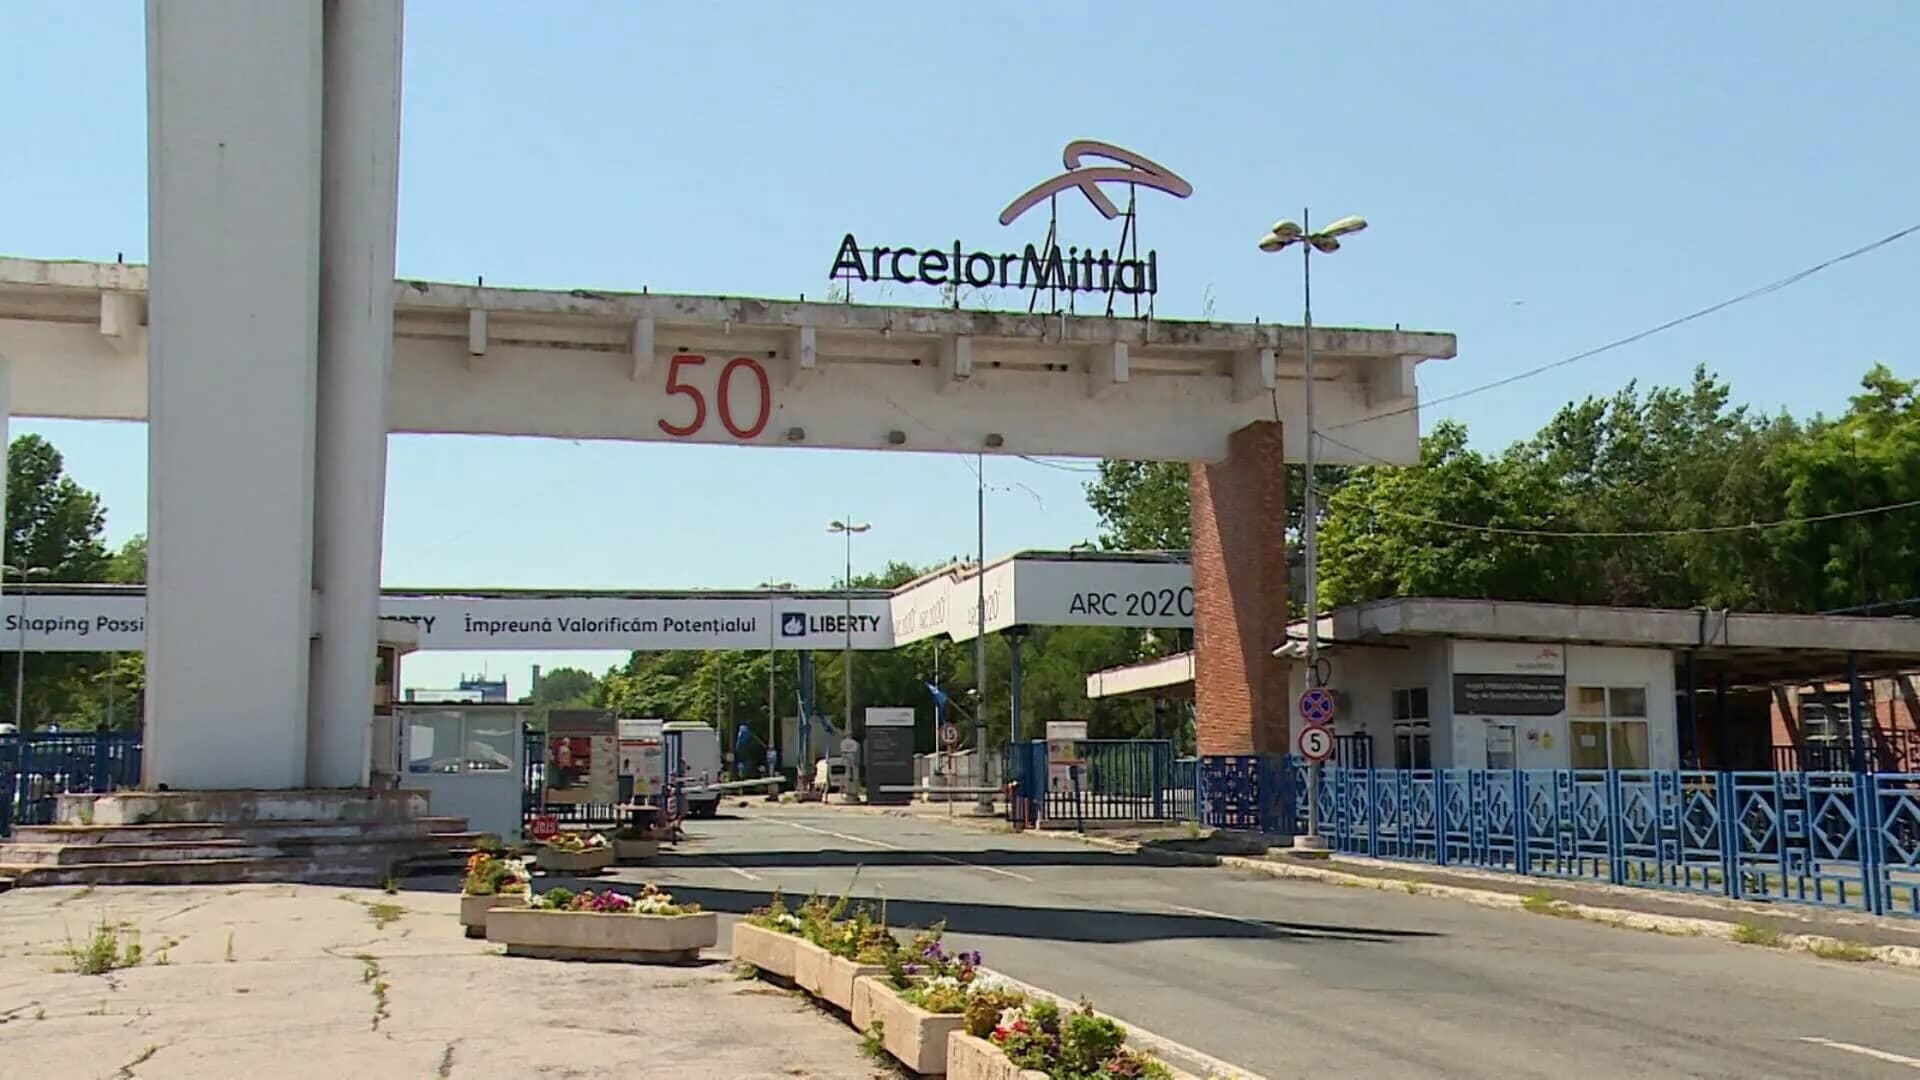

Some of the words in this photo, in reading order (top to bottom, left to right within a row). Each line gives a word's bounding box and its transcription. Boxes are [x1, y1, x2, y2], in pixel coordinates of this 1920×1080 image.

[828, 233, 1158, 295] ArcelorMittal
[657, 354, 772, 439] 50
[1069, 592, 1118, 616] ARC
[1125, 586, 1194, 617] 2020
[5, 614, 90, 636] Shaping
[557, 616, 658, 633] Valorificăm
[663, 616, 756, 636] Potențialul
[810, 615, 881, 633] LIBERTY
[1310, 733, 1321, 753] 5
